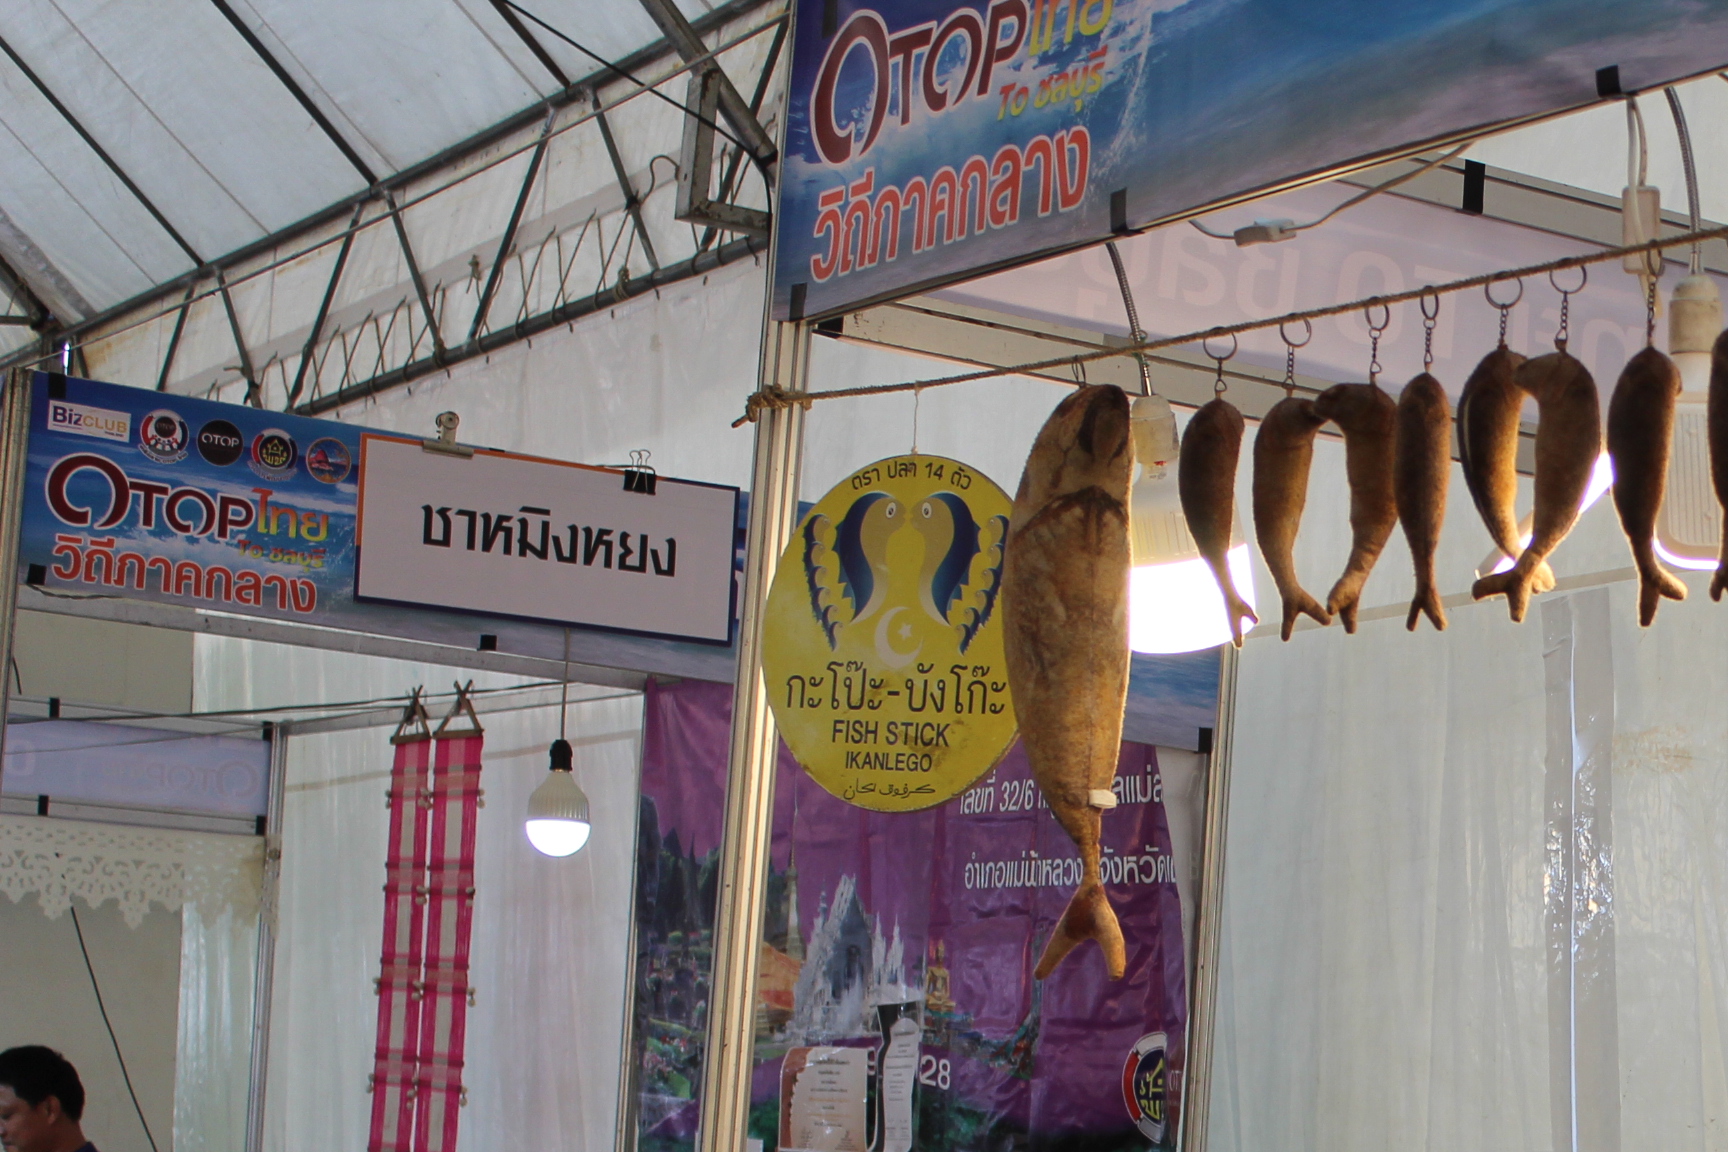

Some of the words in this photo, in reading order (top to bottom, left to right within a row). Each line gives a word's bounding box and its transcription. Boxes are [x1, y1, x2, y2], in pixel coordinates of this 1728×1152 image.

[811, 125, 1091, 283] วิถีภาคกลาง
[201, 432, 240, 449] OTOP
[852, 467, 880, 490] ตรา
[887, 460, 917, 479] ปลา
[925, 462, 944, 481] 14
[951, 466, 972, 491] ตัว
[421, 504, 677, 577] ชาหมิงหยง
[53, 533, 317, 613] วิถีภาคกลาง
[832, 719, 879, 744] FISH
[885, 721, 951, 748] STICK
[845, 751, 933, 773] IKANLEGO
[999, 778, 1035, 813] 32/6
